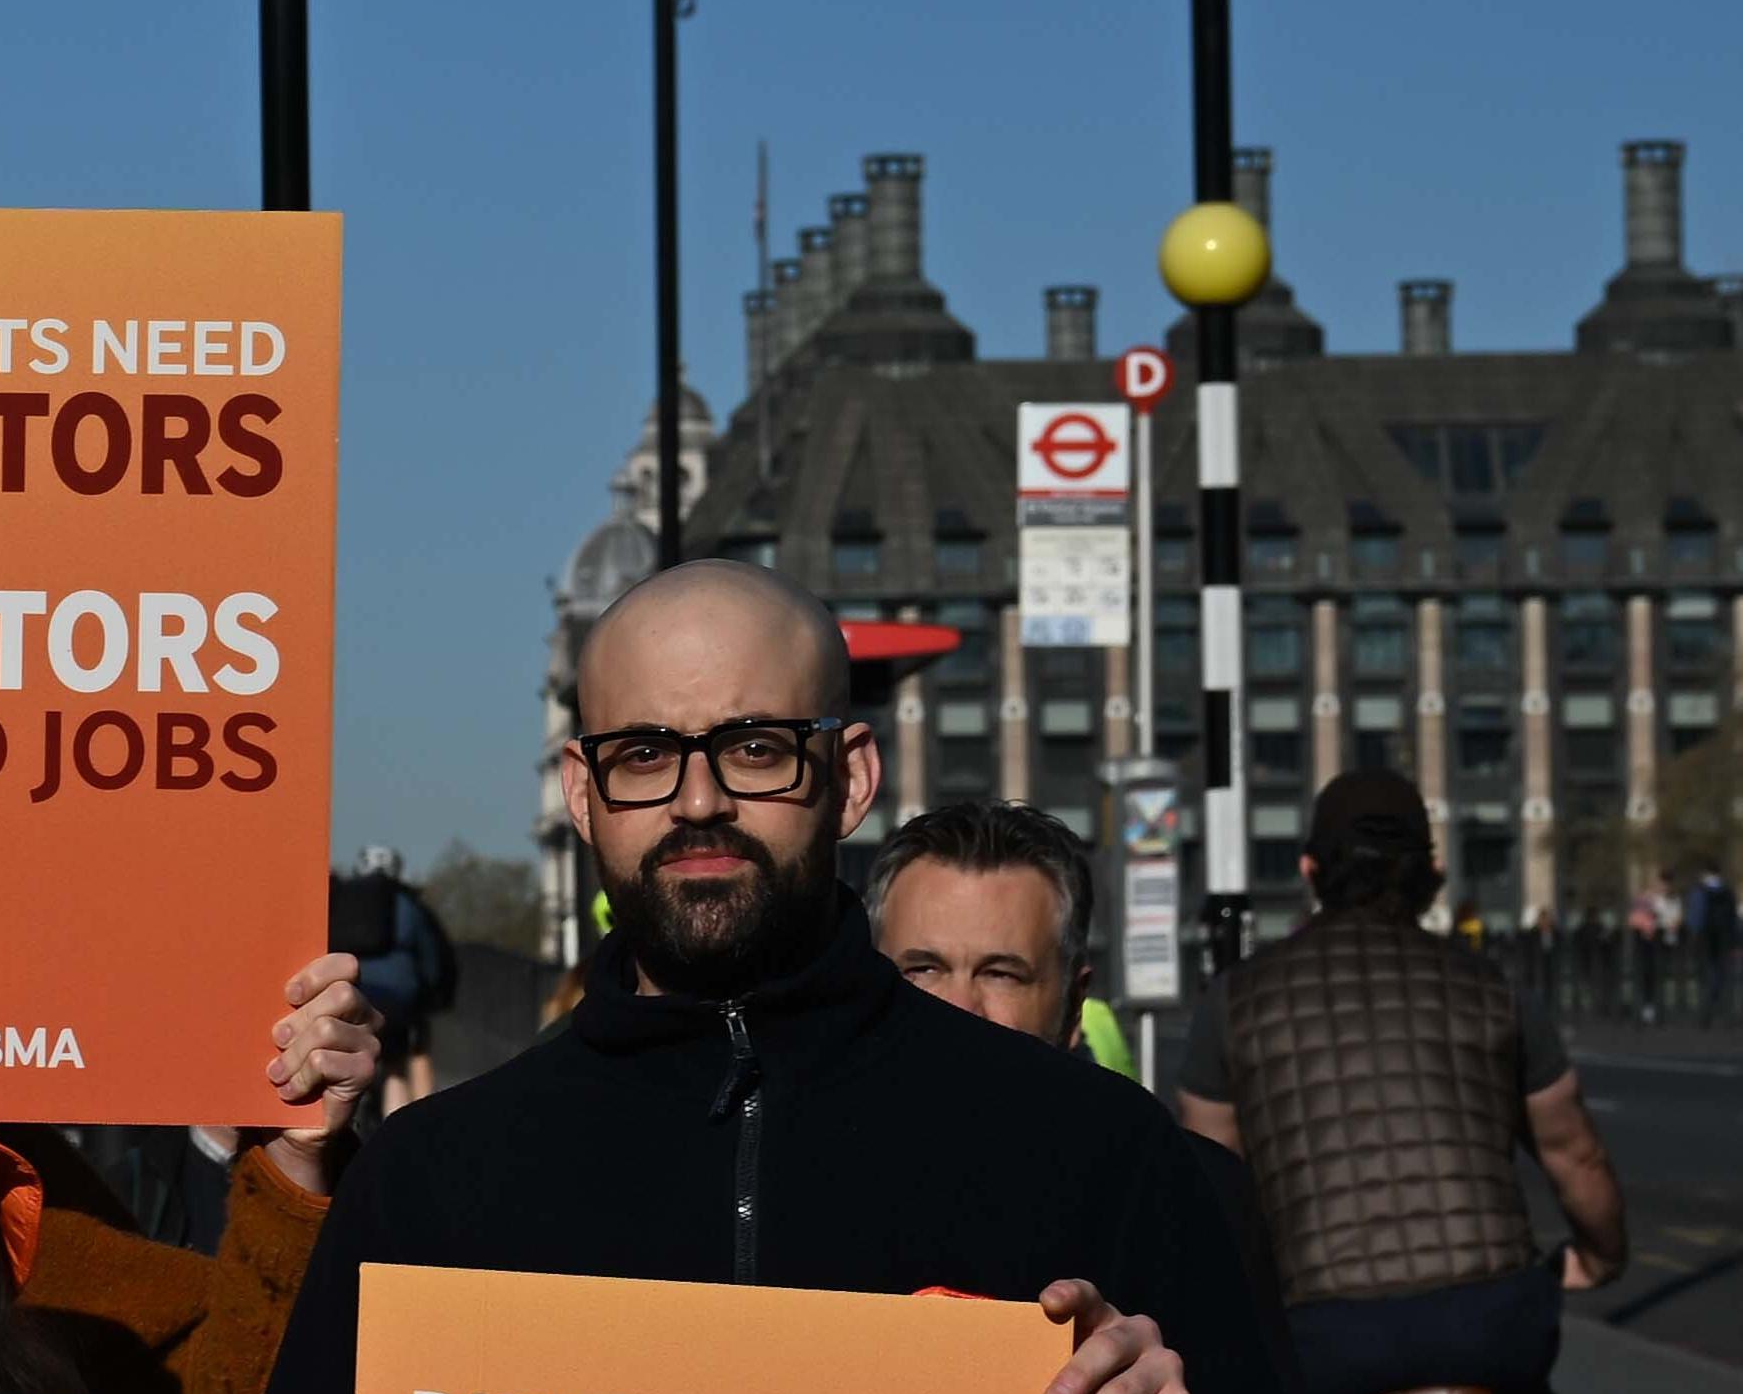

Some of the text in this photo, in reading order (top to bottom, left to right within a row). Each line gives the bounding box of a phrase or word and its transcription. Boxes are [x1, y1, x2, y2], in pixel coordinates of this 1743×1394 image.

[90, 320, 286, 376] NEED
[1125, 351, 1167, 398] D
[29, 709, 279, 804] JOBS
